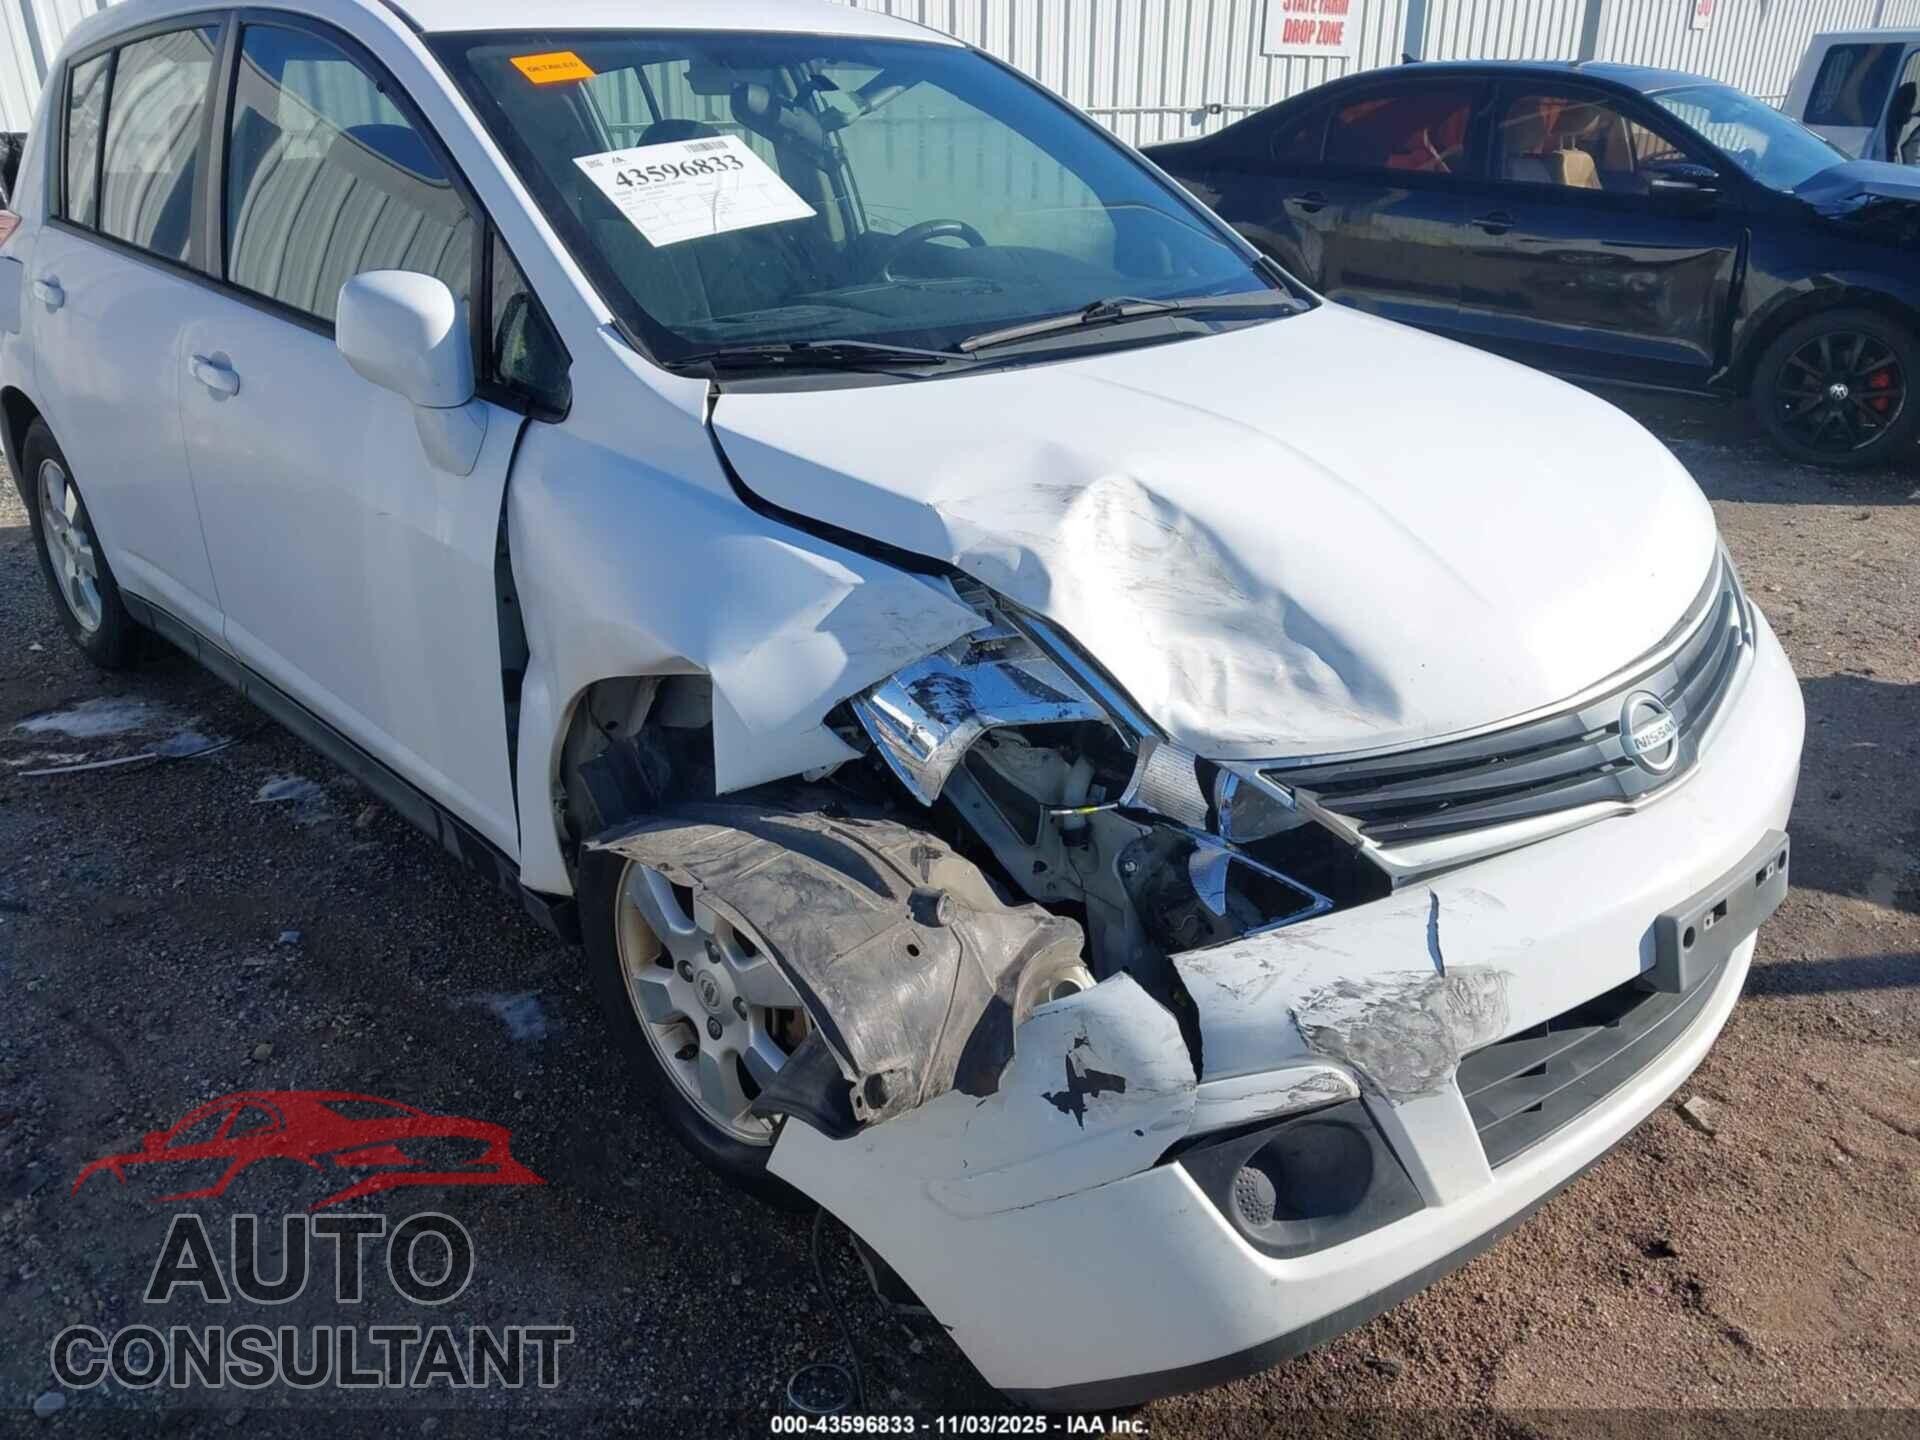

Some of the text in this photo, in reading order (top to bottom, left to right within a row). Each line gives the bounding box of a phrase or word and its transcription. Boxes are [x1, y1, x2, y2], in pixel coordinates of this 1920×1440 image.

[1282, 18, 1345, 46] DROP ZONE
[615, 154, 744, 187] 43596833
[1634, 719, 1677, 750] NISSAN
